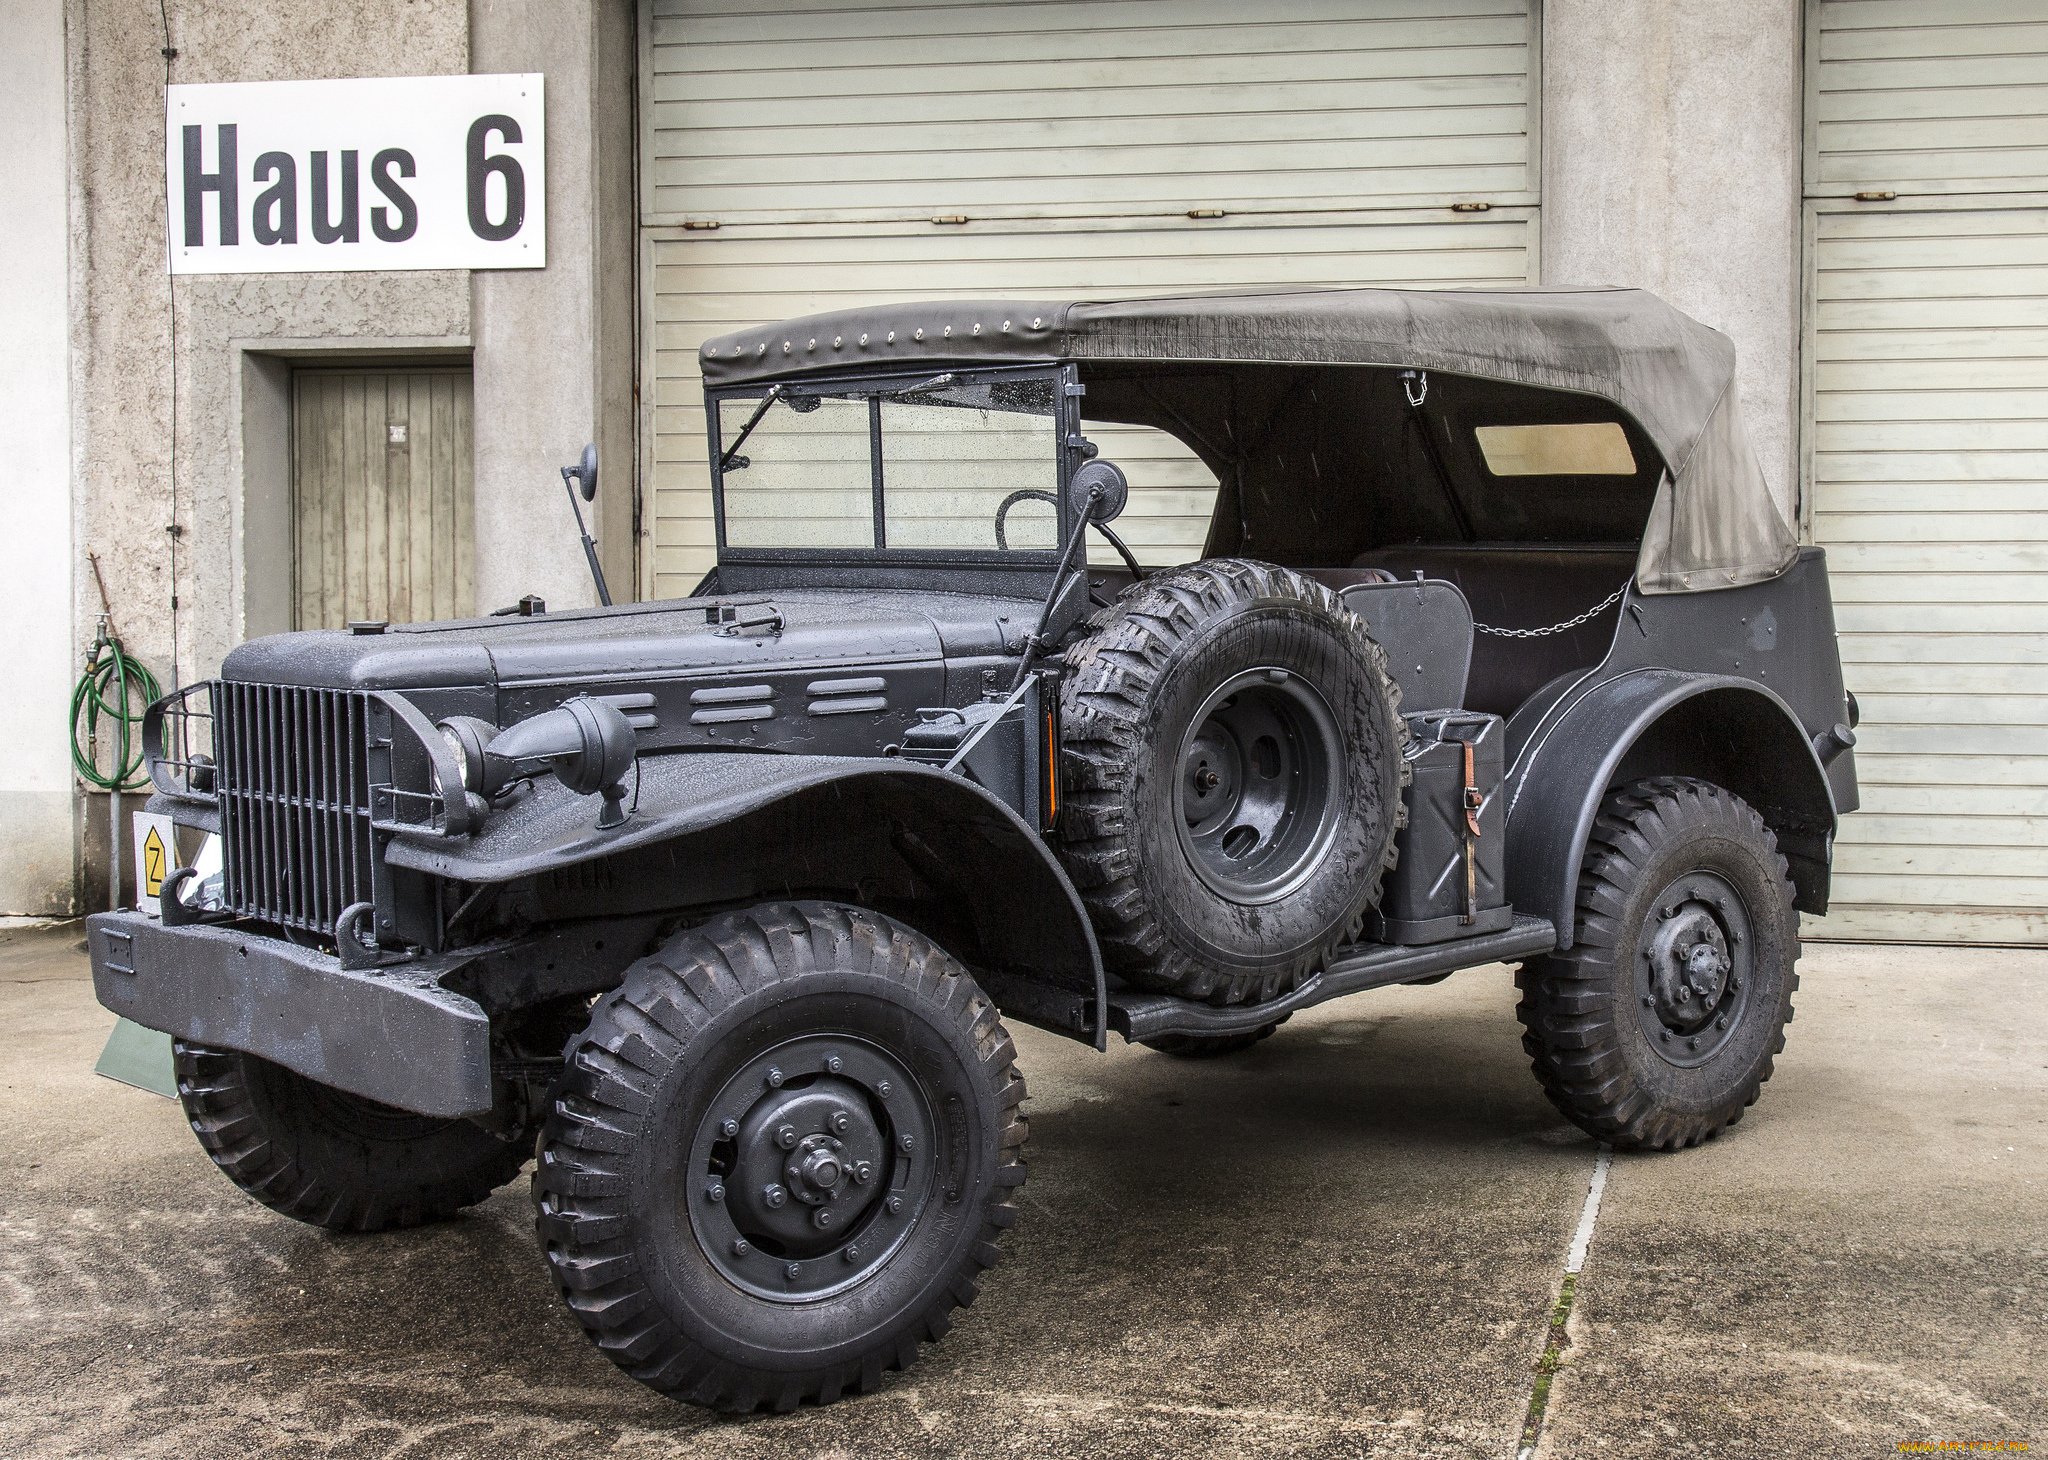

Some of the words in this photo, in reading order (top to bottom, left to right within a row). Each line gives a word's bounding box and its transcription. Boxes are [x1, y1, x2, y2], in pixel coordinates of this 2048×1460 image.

[183, 123, 418, 247] Haus
[466, 114, 526, 242] 6
[149, 847, 163, 883] Z
